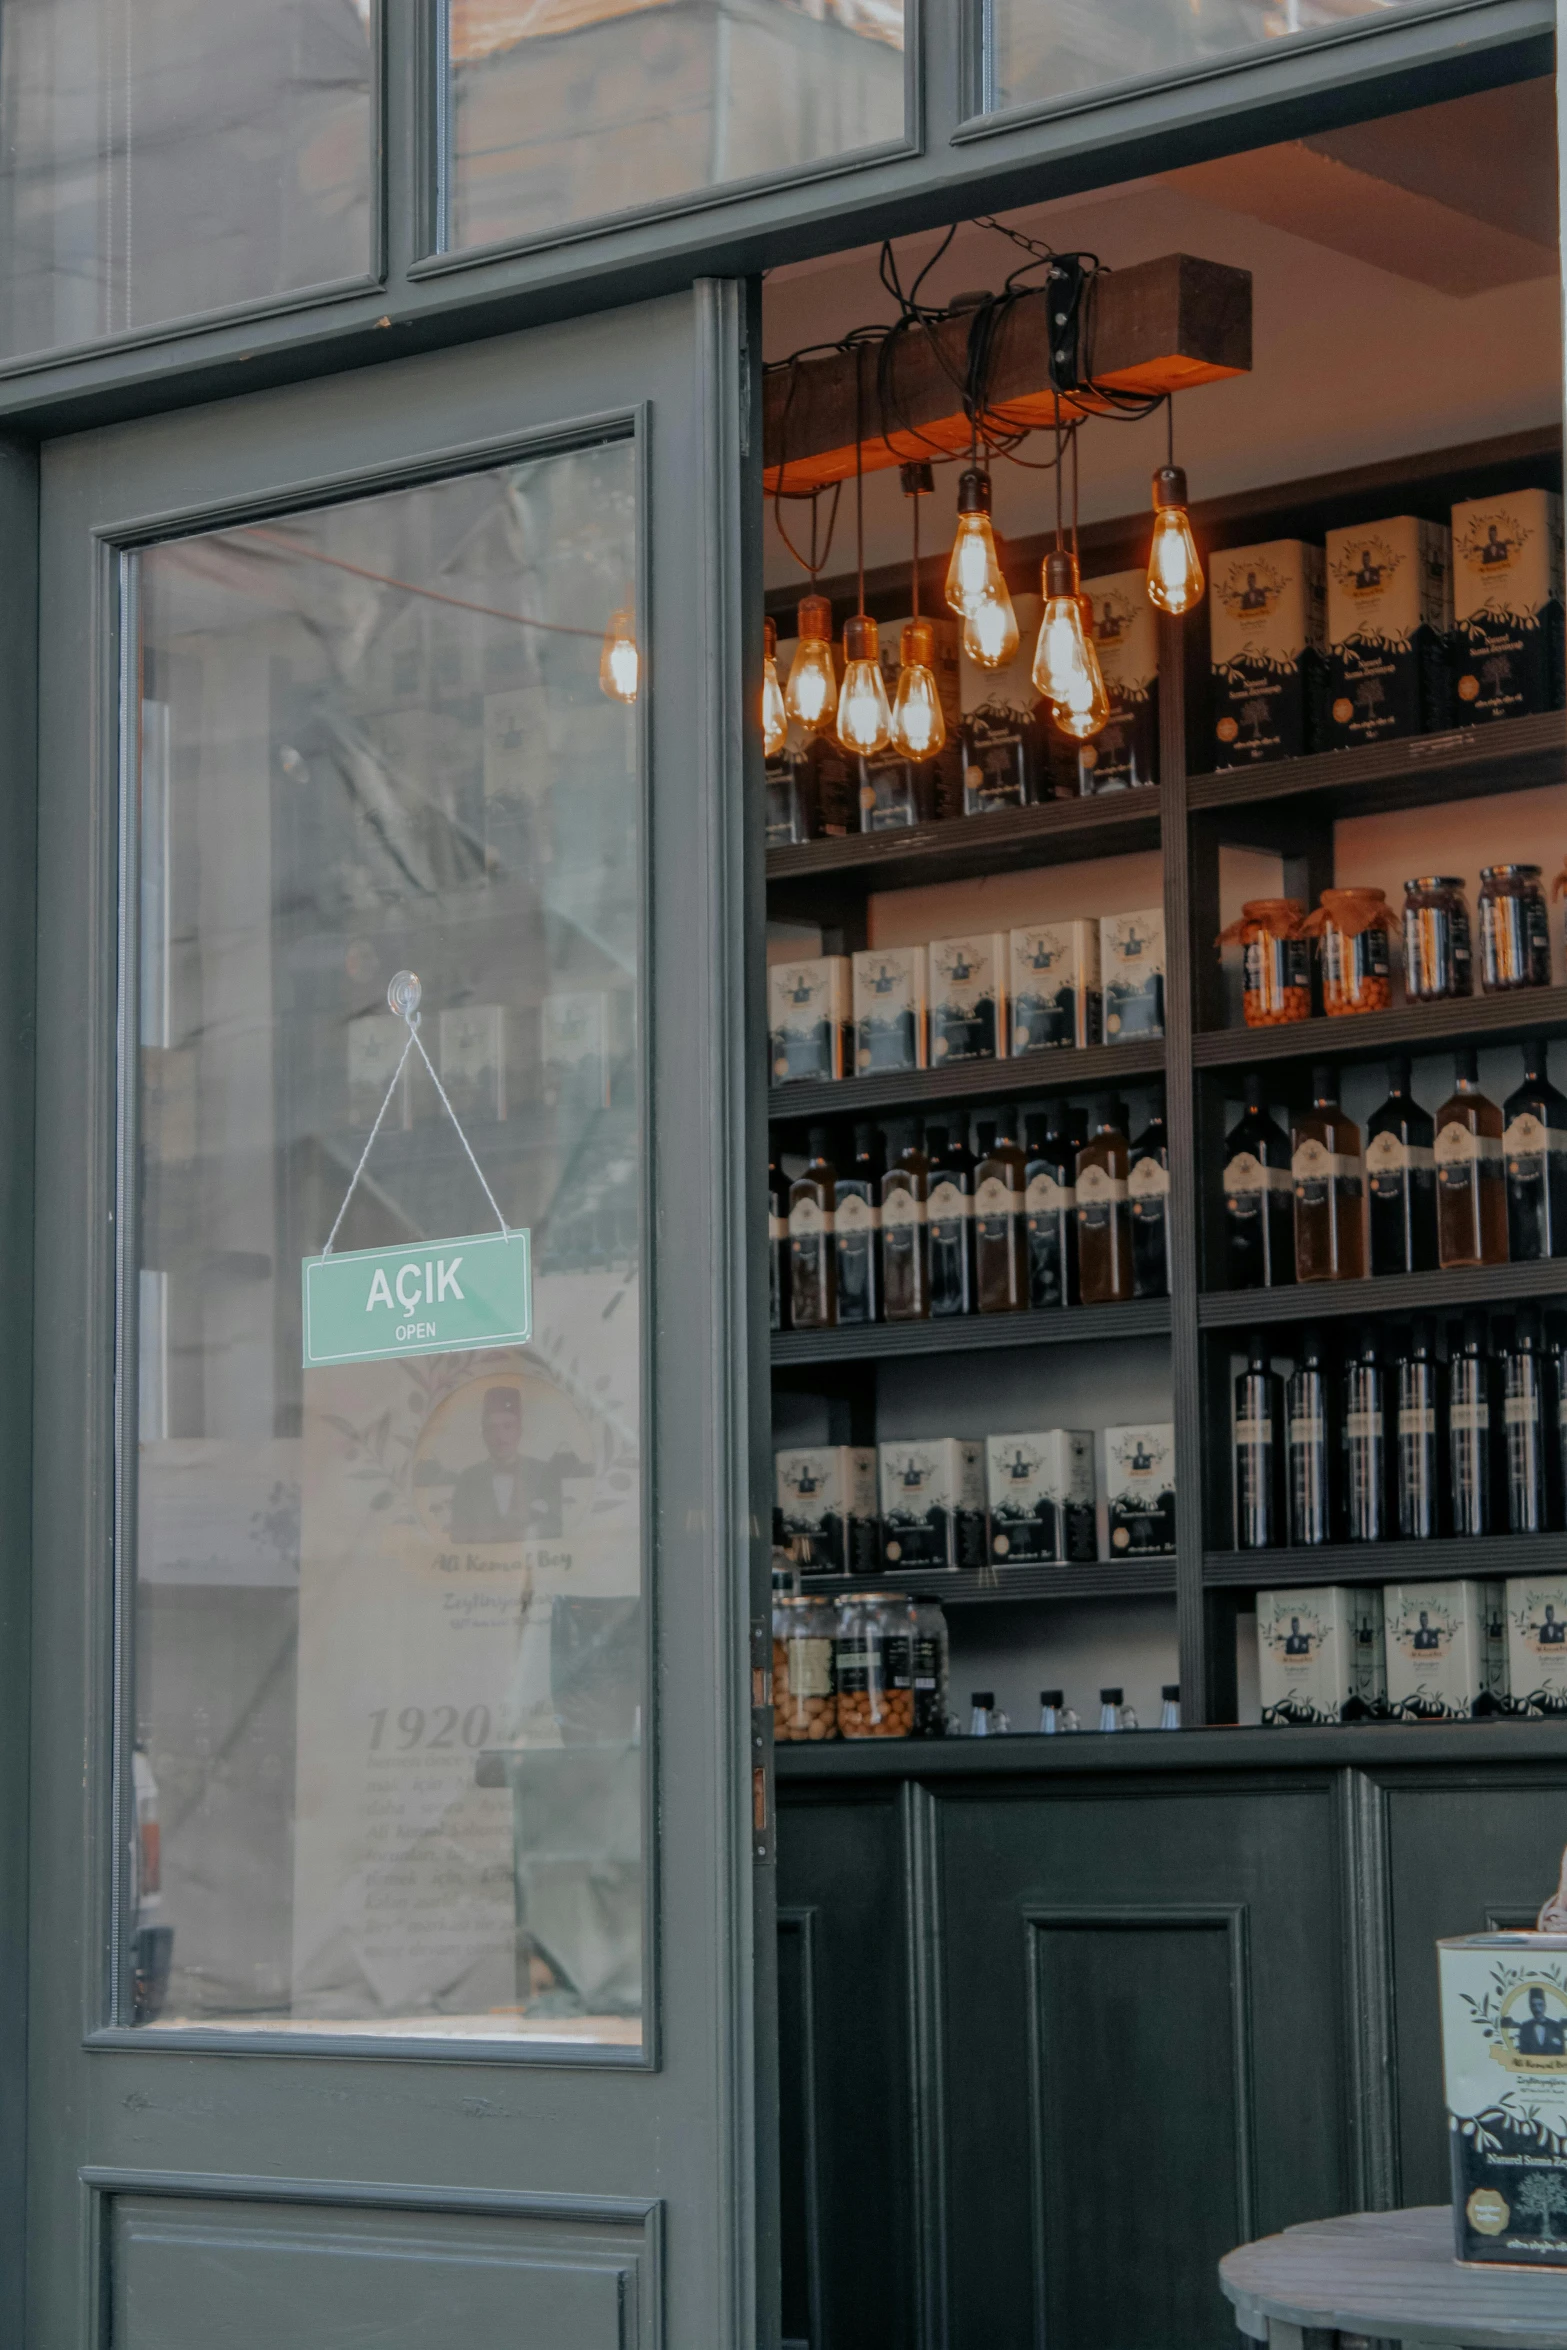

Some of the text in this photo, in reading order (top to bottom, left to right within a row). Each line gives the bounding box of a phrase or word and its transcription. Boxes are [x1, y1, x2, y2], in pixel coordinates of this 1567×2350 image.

[366, 1257, 465, 1317] AÇIK
[395, 1321, 436, 1341] OPEN
[536, 1549, 573, 1571] Bey
[367, 1703, 492, 1751] 1920
